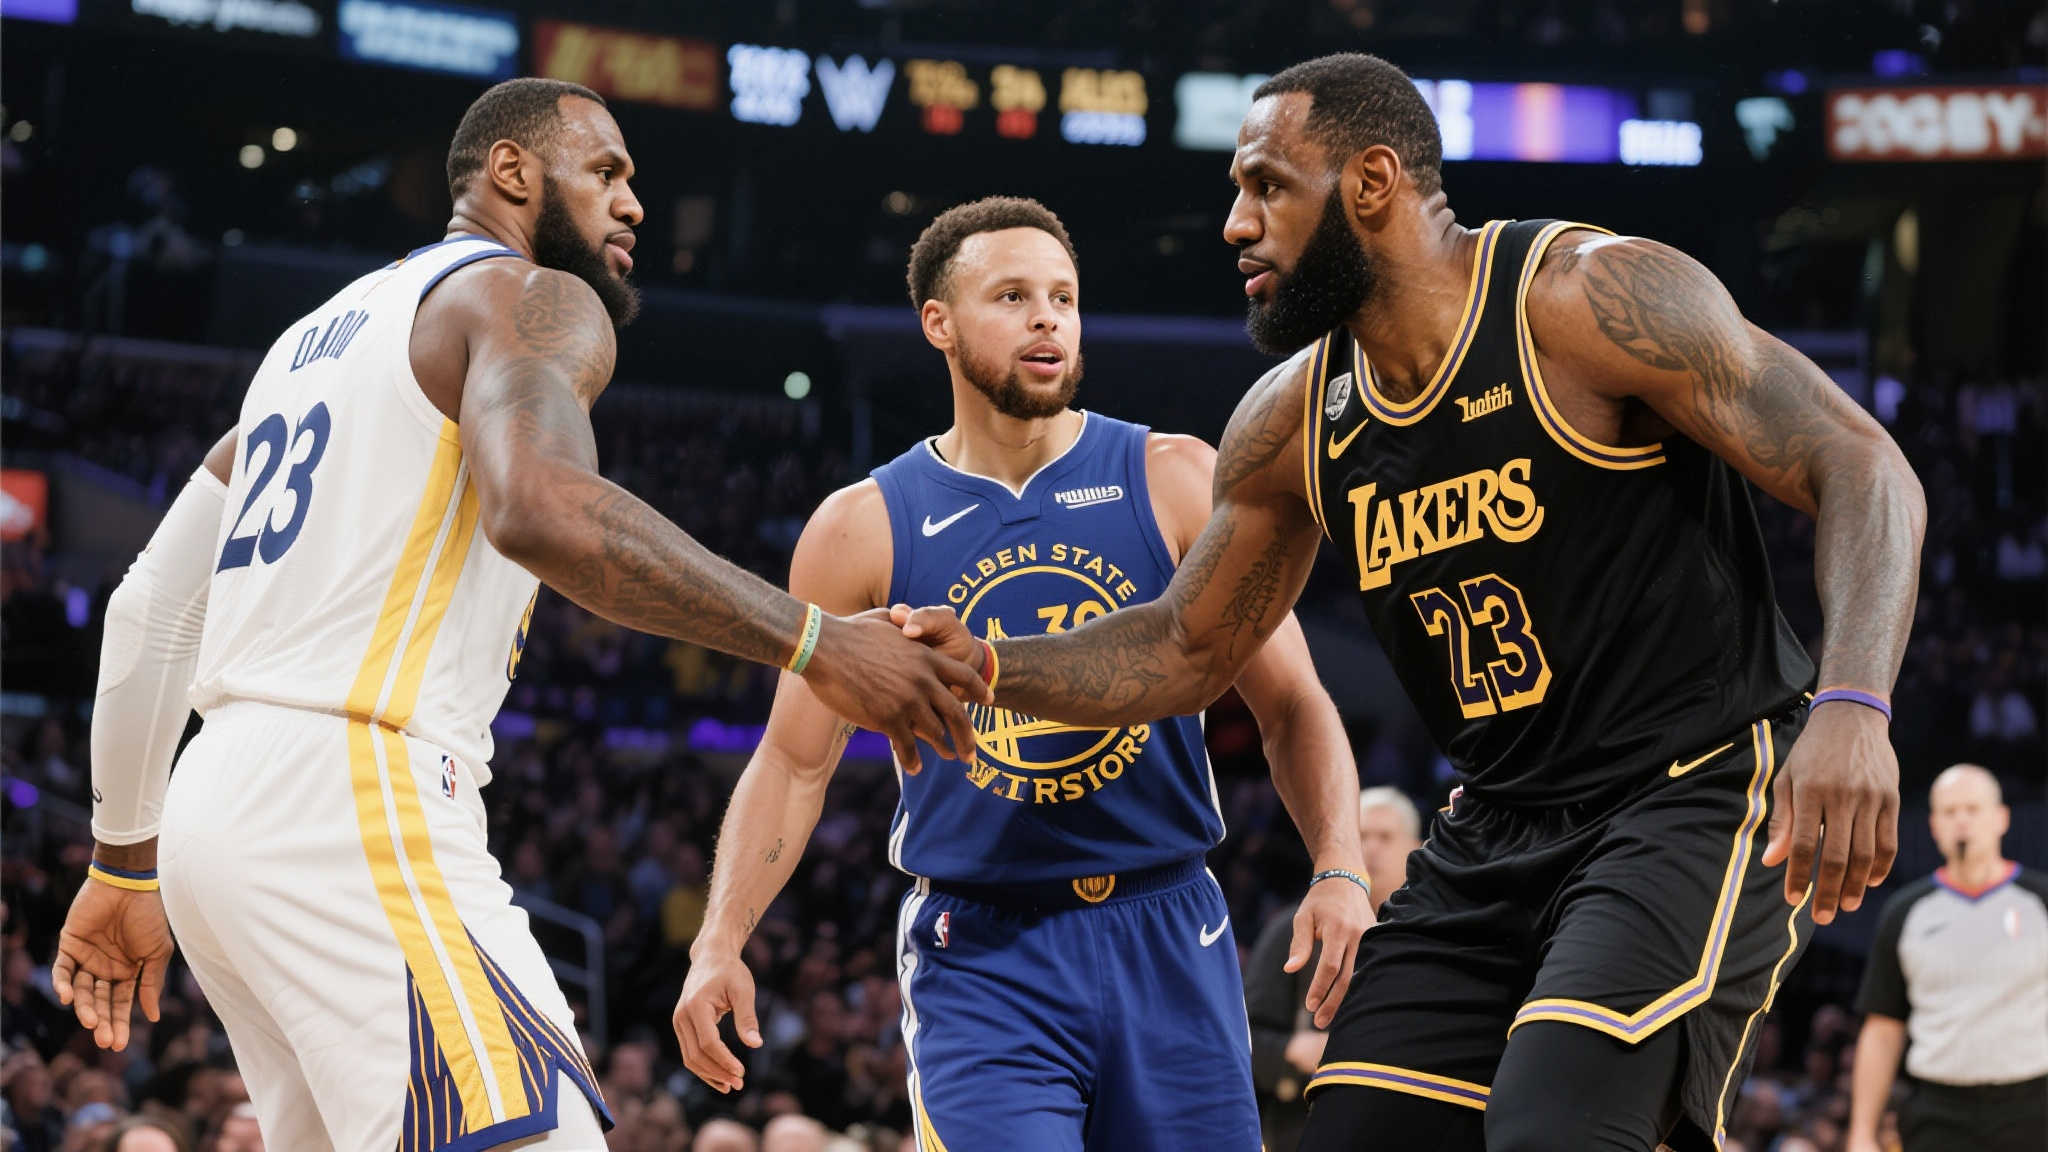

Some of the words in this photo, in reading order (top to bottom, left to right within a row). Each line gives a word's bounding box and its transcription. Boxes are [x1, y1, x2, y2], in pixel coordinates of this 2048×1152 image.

[215, 400, 332, 576] 23
[1347, 458, 1545, 592] LAKERS
[1050, 543, 1138, 602] STATE
[1409, 573, 1553, 720] 23
